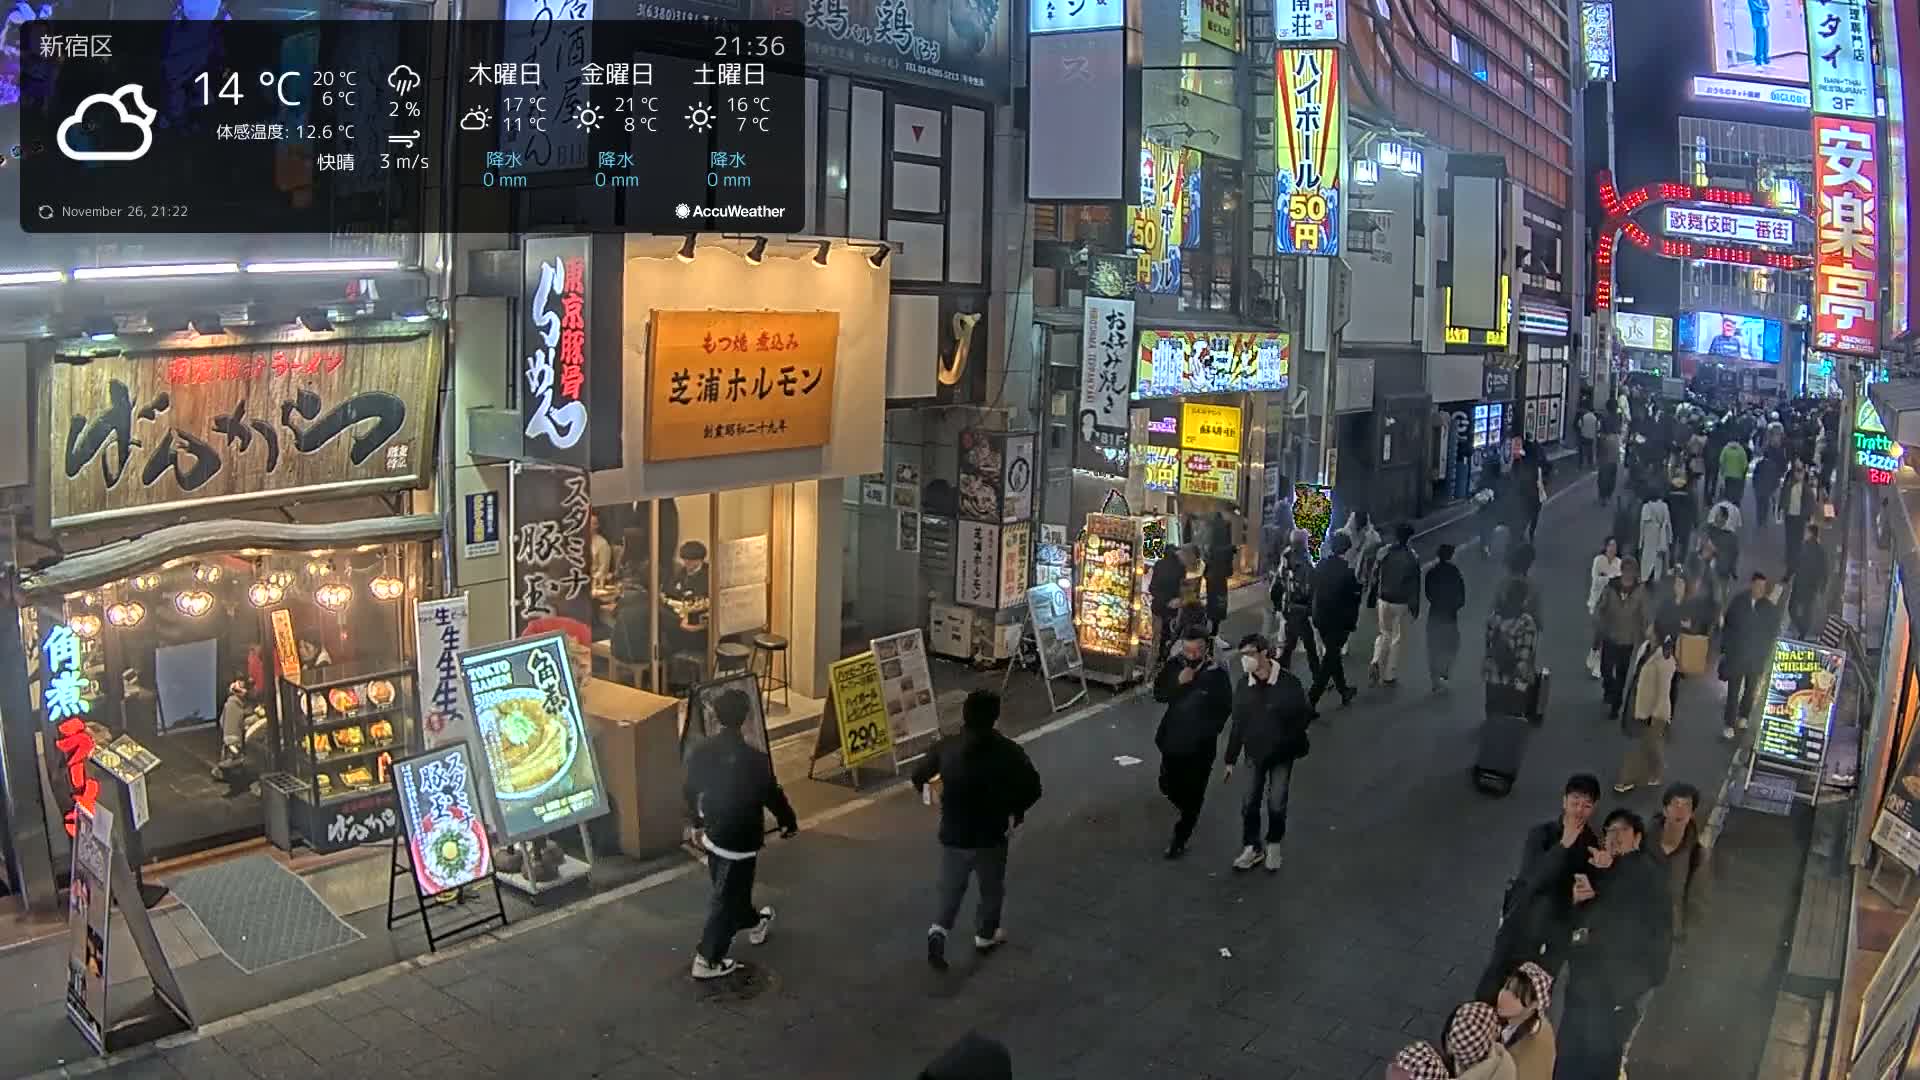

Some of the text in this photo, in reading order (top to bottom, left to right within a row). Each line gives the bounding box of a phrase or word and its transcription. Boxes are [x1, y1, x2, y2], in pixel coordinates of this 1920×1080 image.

[1817, 0, 1842, 69] タイ
[1588, 62, 1610, 79] 7F
[1832, 96, 1856, 110] 3F
[1294, 54, 1322, 189] ハイボール
[1289, 194, 1327, 222] 50
[1670, 210, 1790, 242] 歌舞伎町一番街
[1134, 219, 1157, 250] 50
[1294, 222, 1320, 250] 円
[1818, 125, 1876, 330] 安楽亭
[561, 256, 585, 401] 東京豚骨
[702, 329, 800, 354] もつ焼 煮込み
[1817, 332, 1837, 348] 2F
[1100, 308, 1129, 415] お好み焼き
[669, 365, 823, 405] 芝浦ホルモン
[65, 378, 408, 492] ばんから
[702, 418, 789, 440] 創業昭和二十九年
[561, 476, 590, 600] スタミナ
[517, 519, 563, 618] 豚玉
[467, 660, 511, 681] TOKYO
[472, 673, 512, 694] RAMEN
[528, 649, 570, 715] 角煮
[848, 721, 879, 753] 290
[419, 760, 454, 822] 豚玉
[446, 751, 477, 833] スタミナ
